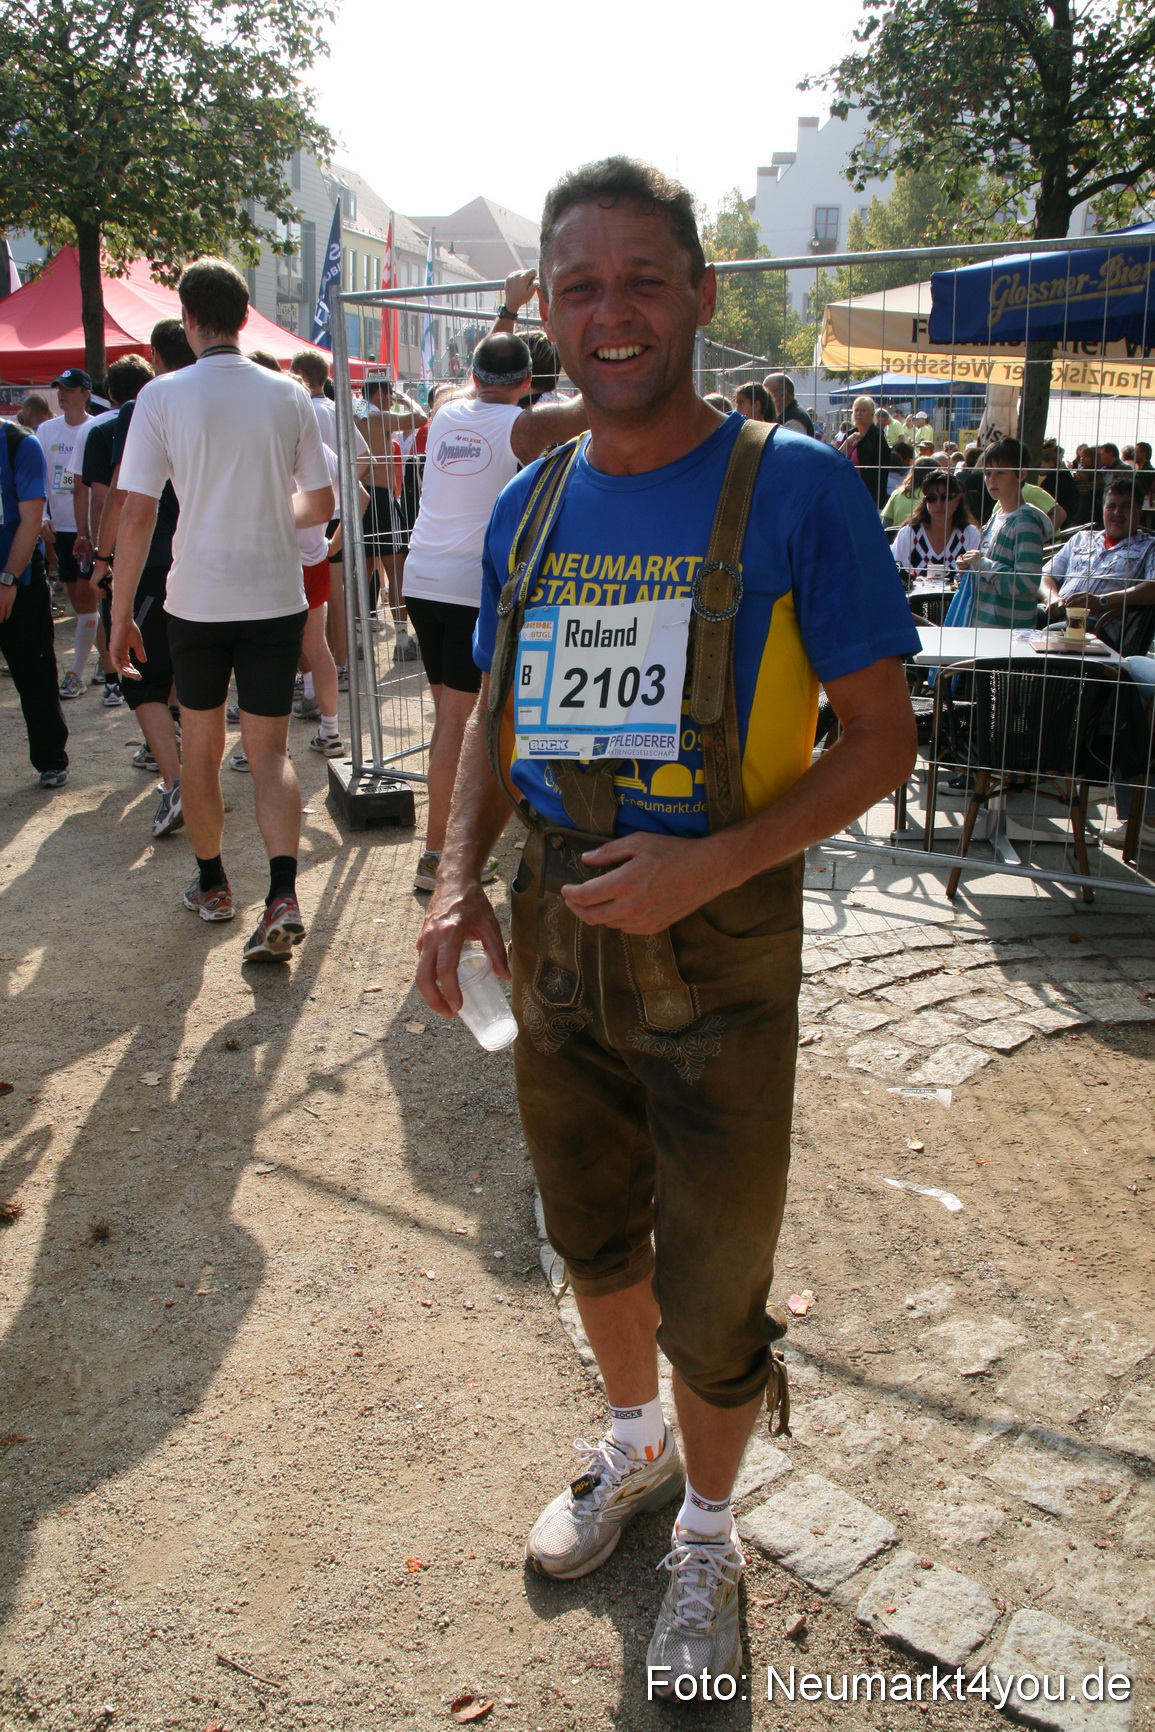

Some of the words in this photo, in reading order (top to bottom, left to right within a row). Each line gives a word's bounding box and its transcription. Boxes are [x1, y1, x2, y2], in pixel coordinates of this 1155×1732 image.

[437, 441, 481, 465] Dynamics
[62, 476, 73, 485] 36
[565, 617, 638, 648] Roland
[521, 665, 532, 686] B
[559, 664, 666, 708] 2103
[529, 740, 568, 751] BOCK
[610, 734, 675, 749] PFLEIDERER
